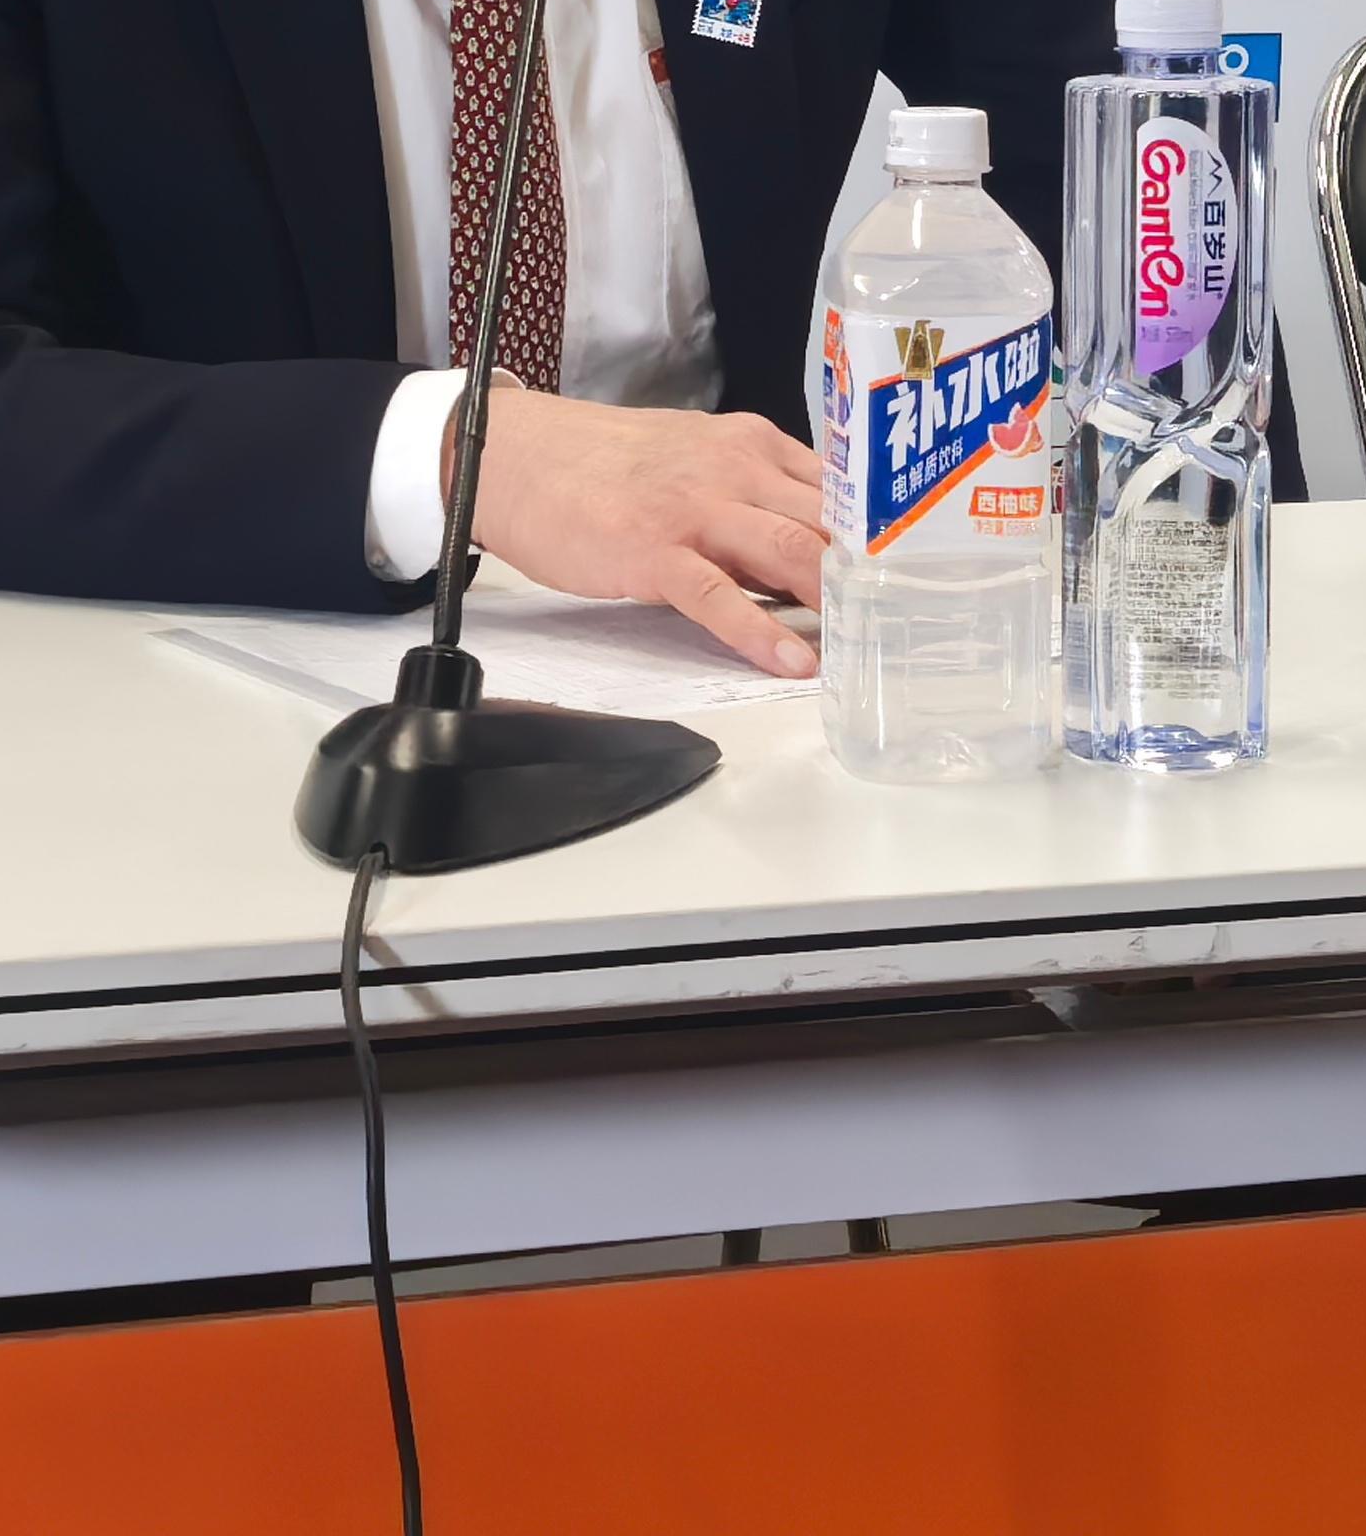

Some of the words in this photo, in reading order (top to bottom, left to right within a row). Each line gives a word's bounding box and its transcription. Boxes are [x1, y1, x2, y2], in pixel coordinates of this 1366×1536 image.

[1203, 200, 1225, 293] 百岁山
[885, 330, 1041, 473] 补水啦
[891, 436, 964, 502] 电解质饮料
